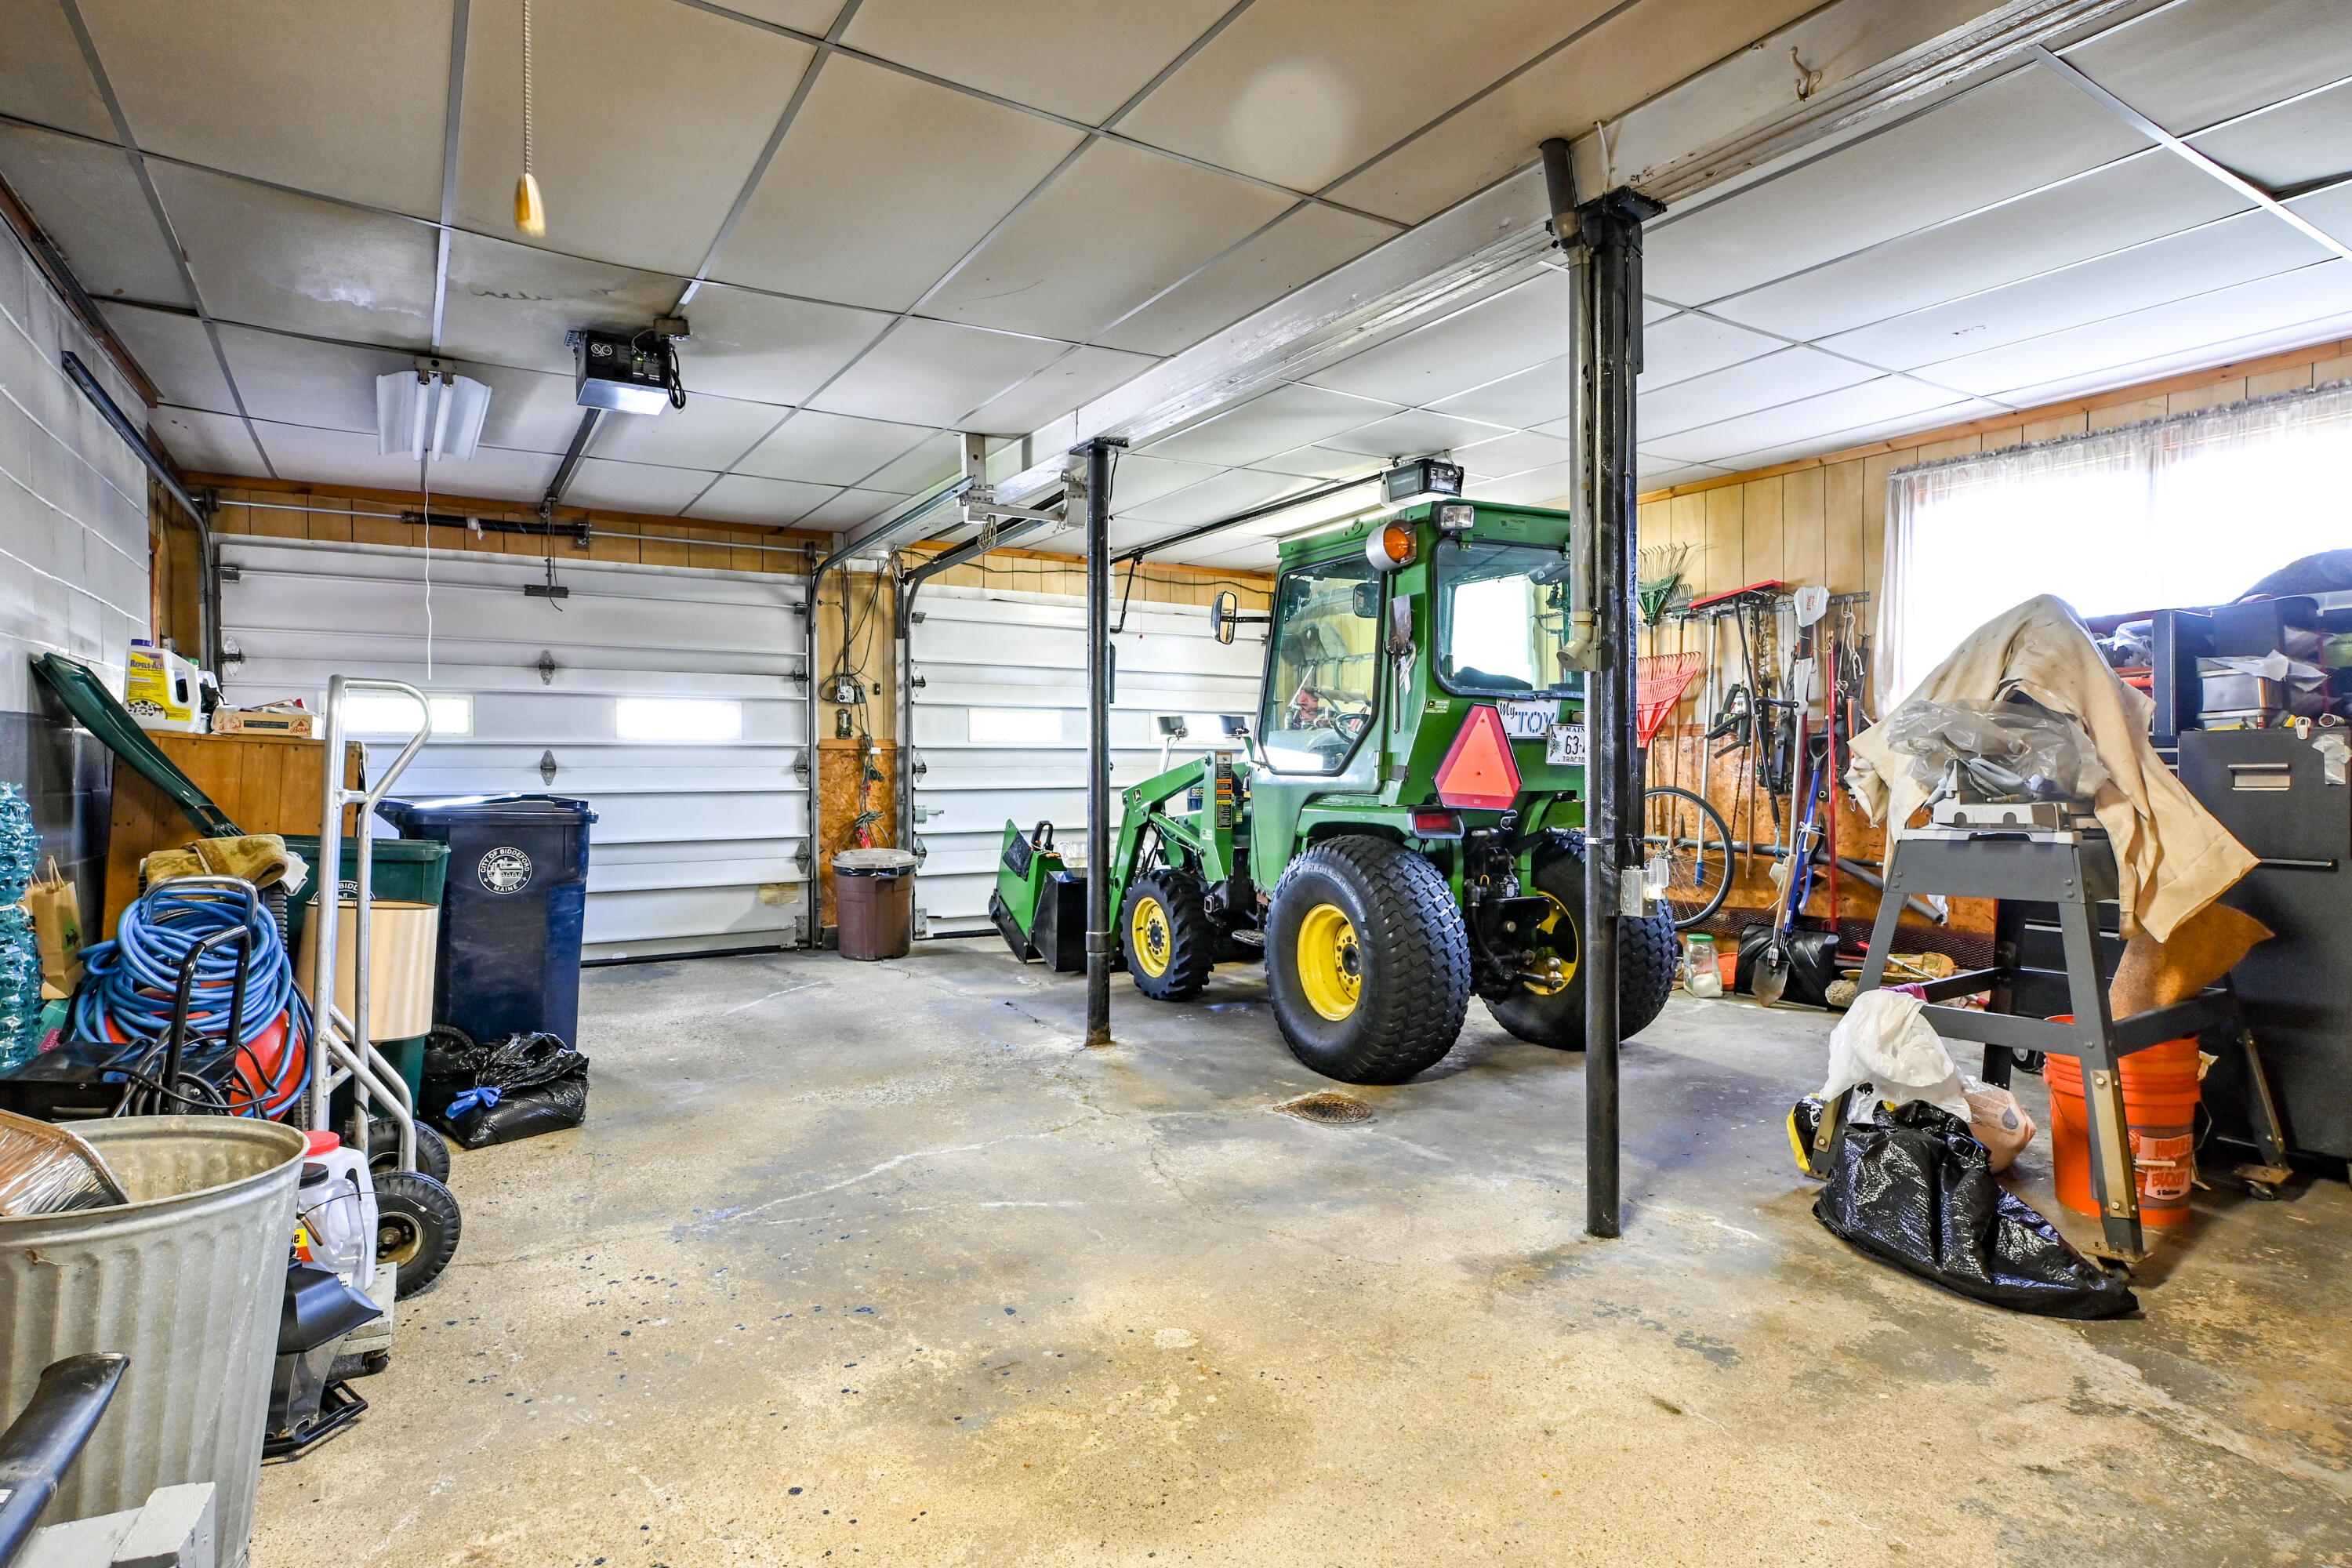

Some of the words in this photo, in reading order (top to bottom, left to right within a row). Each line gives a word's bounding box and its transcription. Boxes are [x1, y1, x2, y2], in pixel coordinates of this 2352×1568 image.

[1499, 702, 1515, 720] My
[1515, 711, 1555, 734] TOY
[1562, 755, 1585, 764] TRACTO
[481, 858, 489, 873] CITY
[488, 851, 498, 859] OF
[500, 849, 530, 872] BIDDEFORD
[493, 884, 518, 892] MAINE
